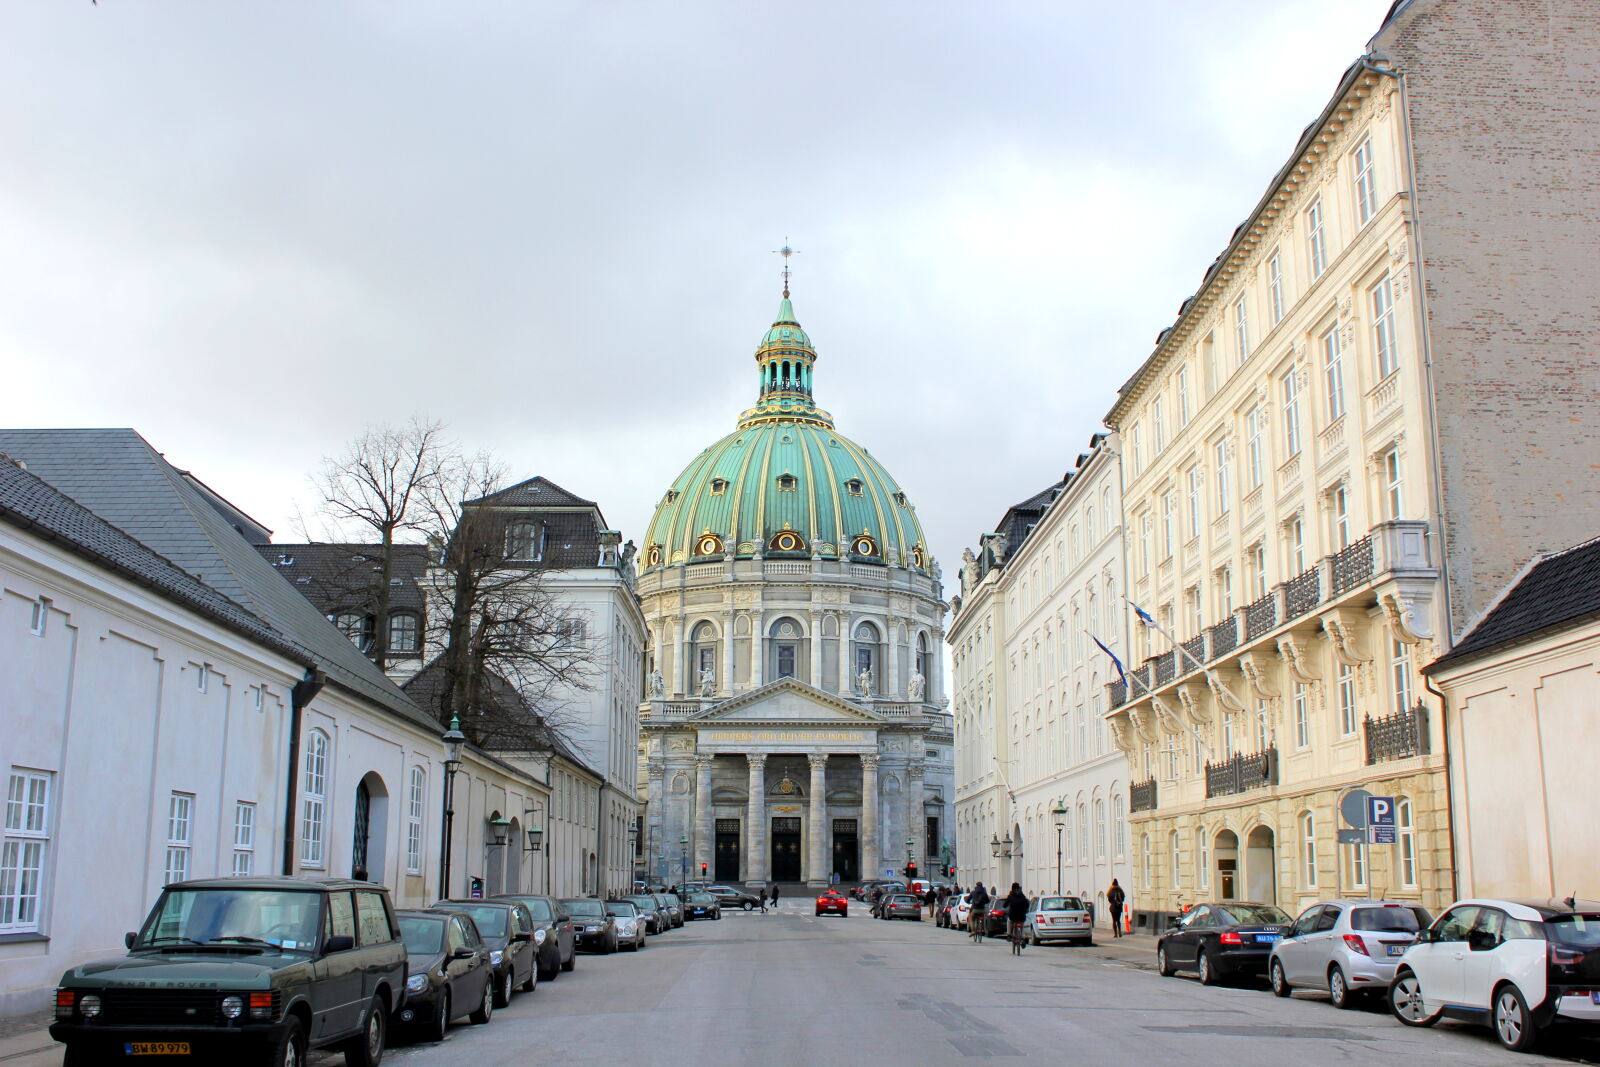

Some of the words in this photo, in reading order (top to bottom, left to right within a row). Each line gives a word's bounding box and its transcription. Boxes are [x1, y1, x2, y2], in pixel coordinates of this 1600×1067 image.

[1374, 800, 1389, 823] P
[132, 1043, 148, 1053] BW
[151, 1043, 164, 1053] 89
[167, 1043, 189, 1053] 979
